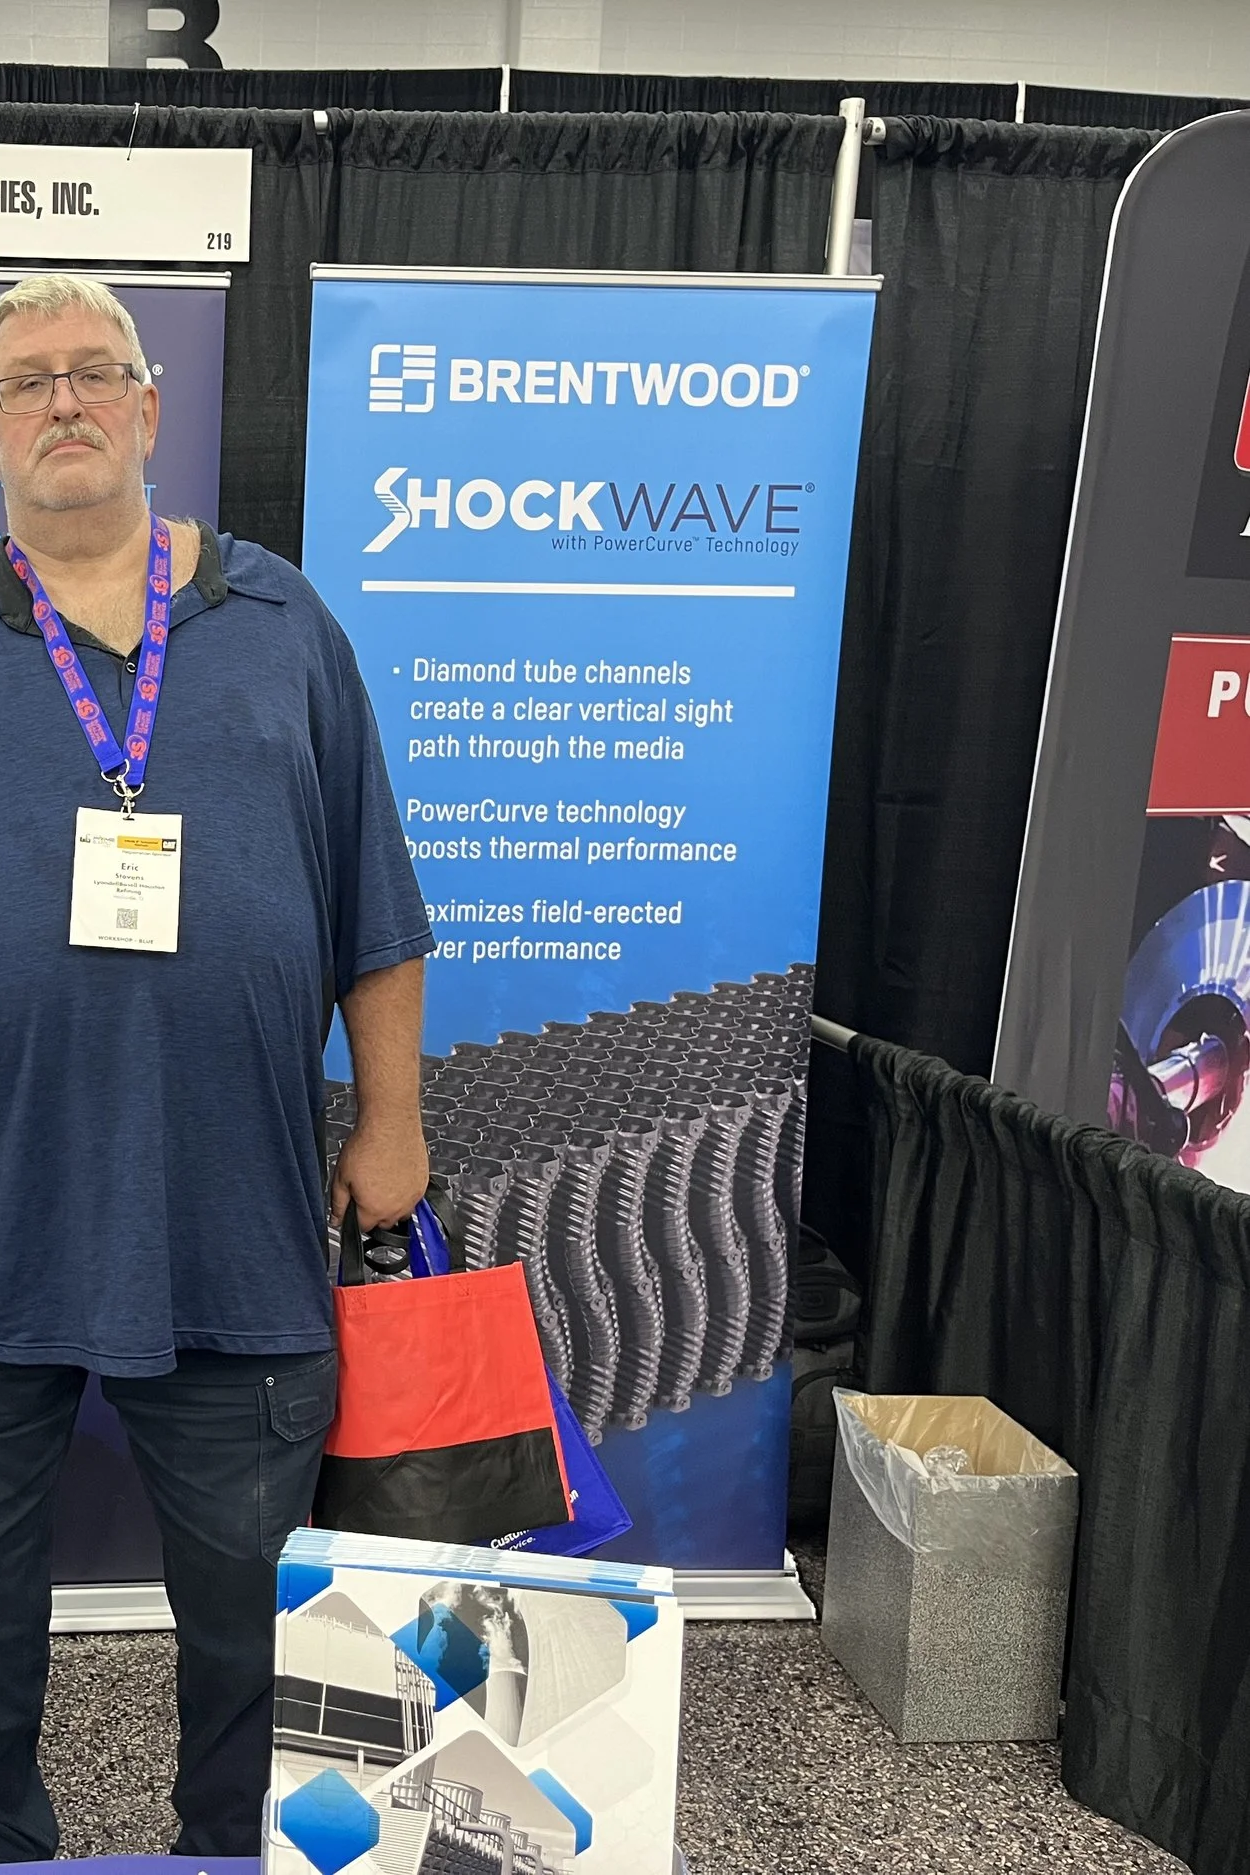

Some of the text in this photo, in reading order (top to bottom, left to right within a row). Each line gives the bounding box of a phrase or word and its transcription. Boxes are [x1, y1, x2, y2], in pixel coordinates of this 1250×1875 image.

[108, 0, 224, 69] B
[53, 182, 99, 215] INC.
[208, 233, 231, 250] 219
[552, 535, 586, 550] with
[706, 537, 798, 556] Technology
[414, 658, 690, 684] Diamond tube channels
[411, 697, 733, 727] create a clear vertical sight
[409, 734, 683, 763] path through the media
[408, 799, 686, 828] PowerCurve technology
[406, 836, 736, 864] boosts thermal performance
[121, 862, 139, 871] Eric
[425, 898, 681, 923] aximizes field-erected
[473, 937, 620, 963] performance
